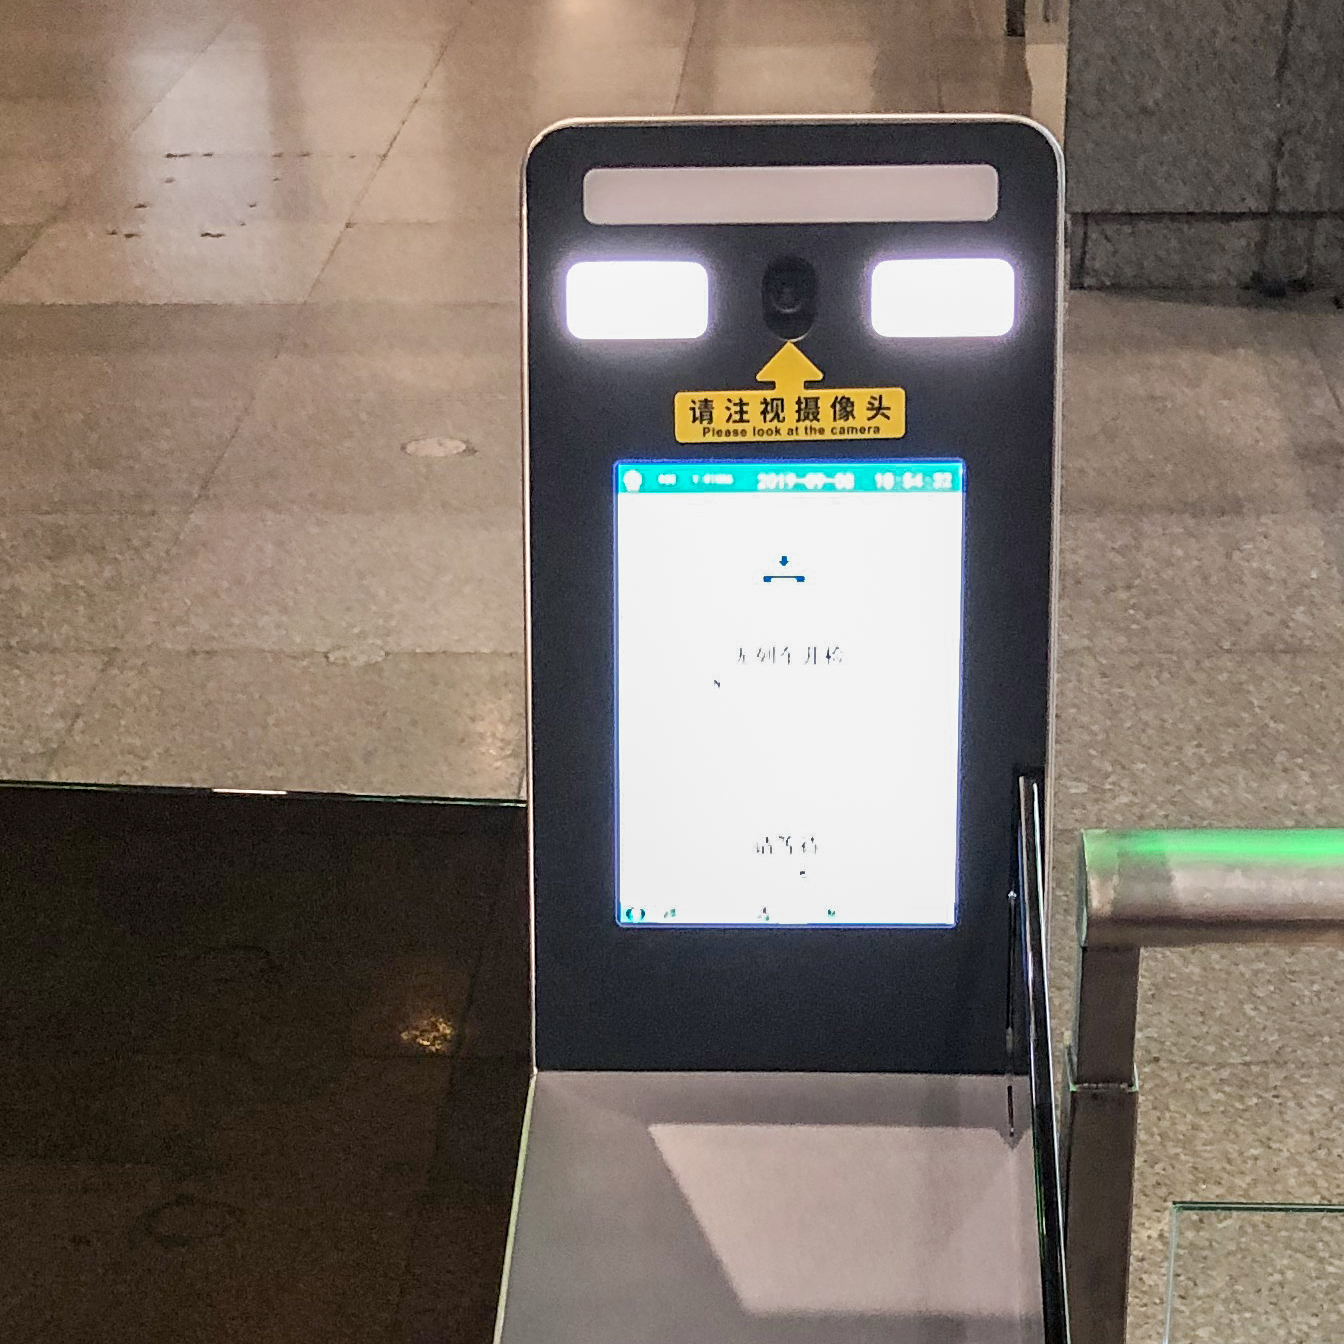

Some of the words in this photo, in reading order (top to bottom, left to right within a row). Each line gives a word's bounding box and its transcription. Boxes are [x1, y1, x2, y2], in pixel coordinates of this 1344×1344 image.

[689, 394, 892, 425] 请注视摄像头
[702, 426, 748, 438] Please
[753, 425, 782, 437] look
[787, 426, 800, 436] at
[804, 425, 825, 436] the
[830, 425, 881, 436] camera
